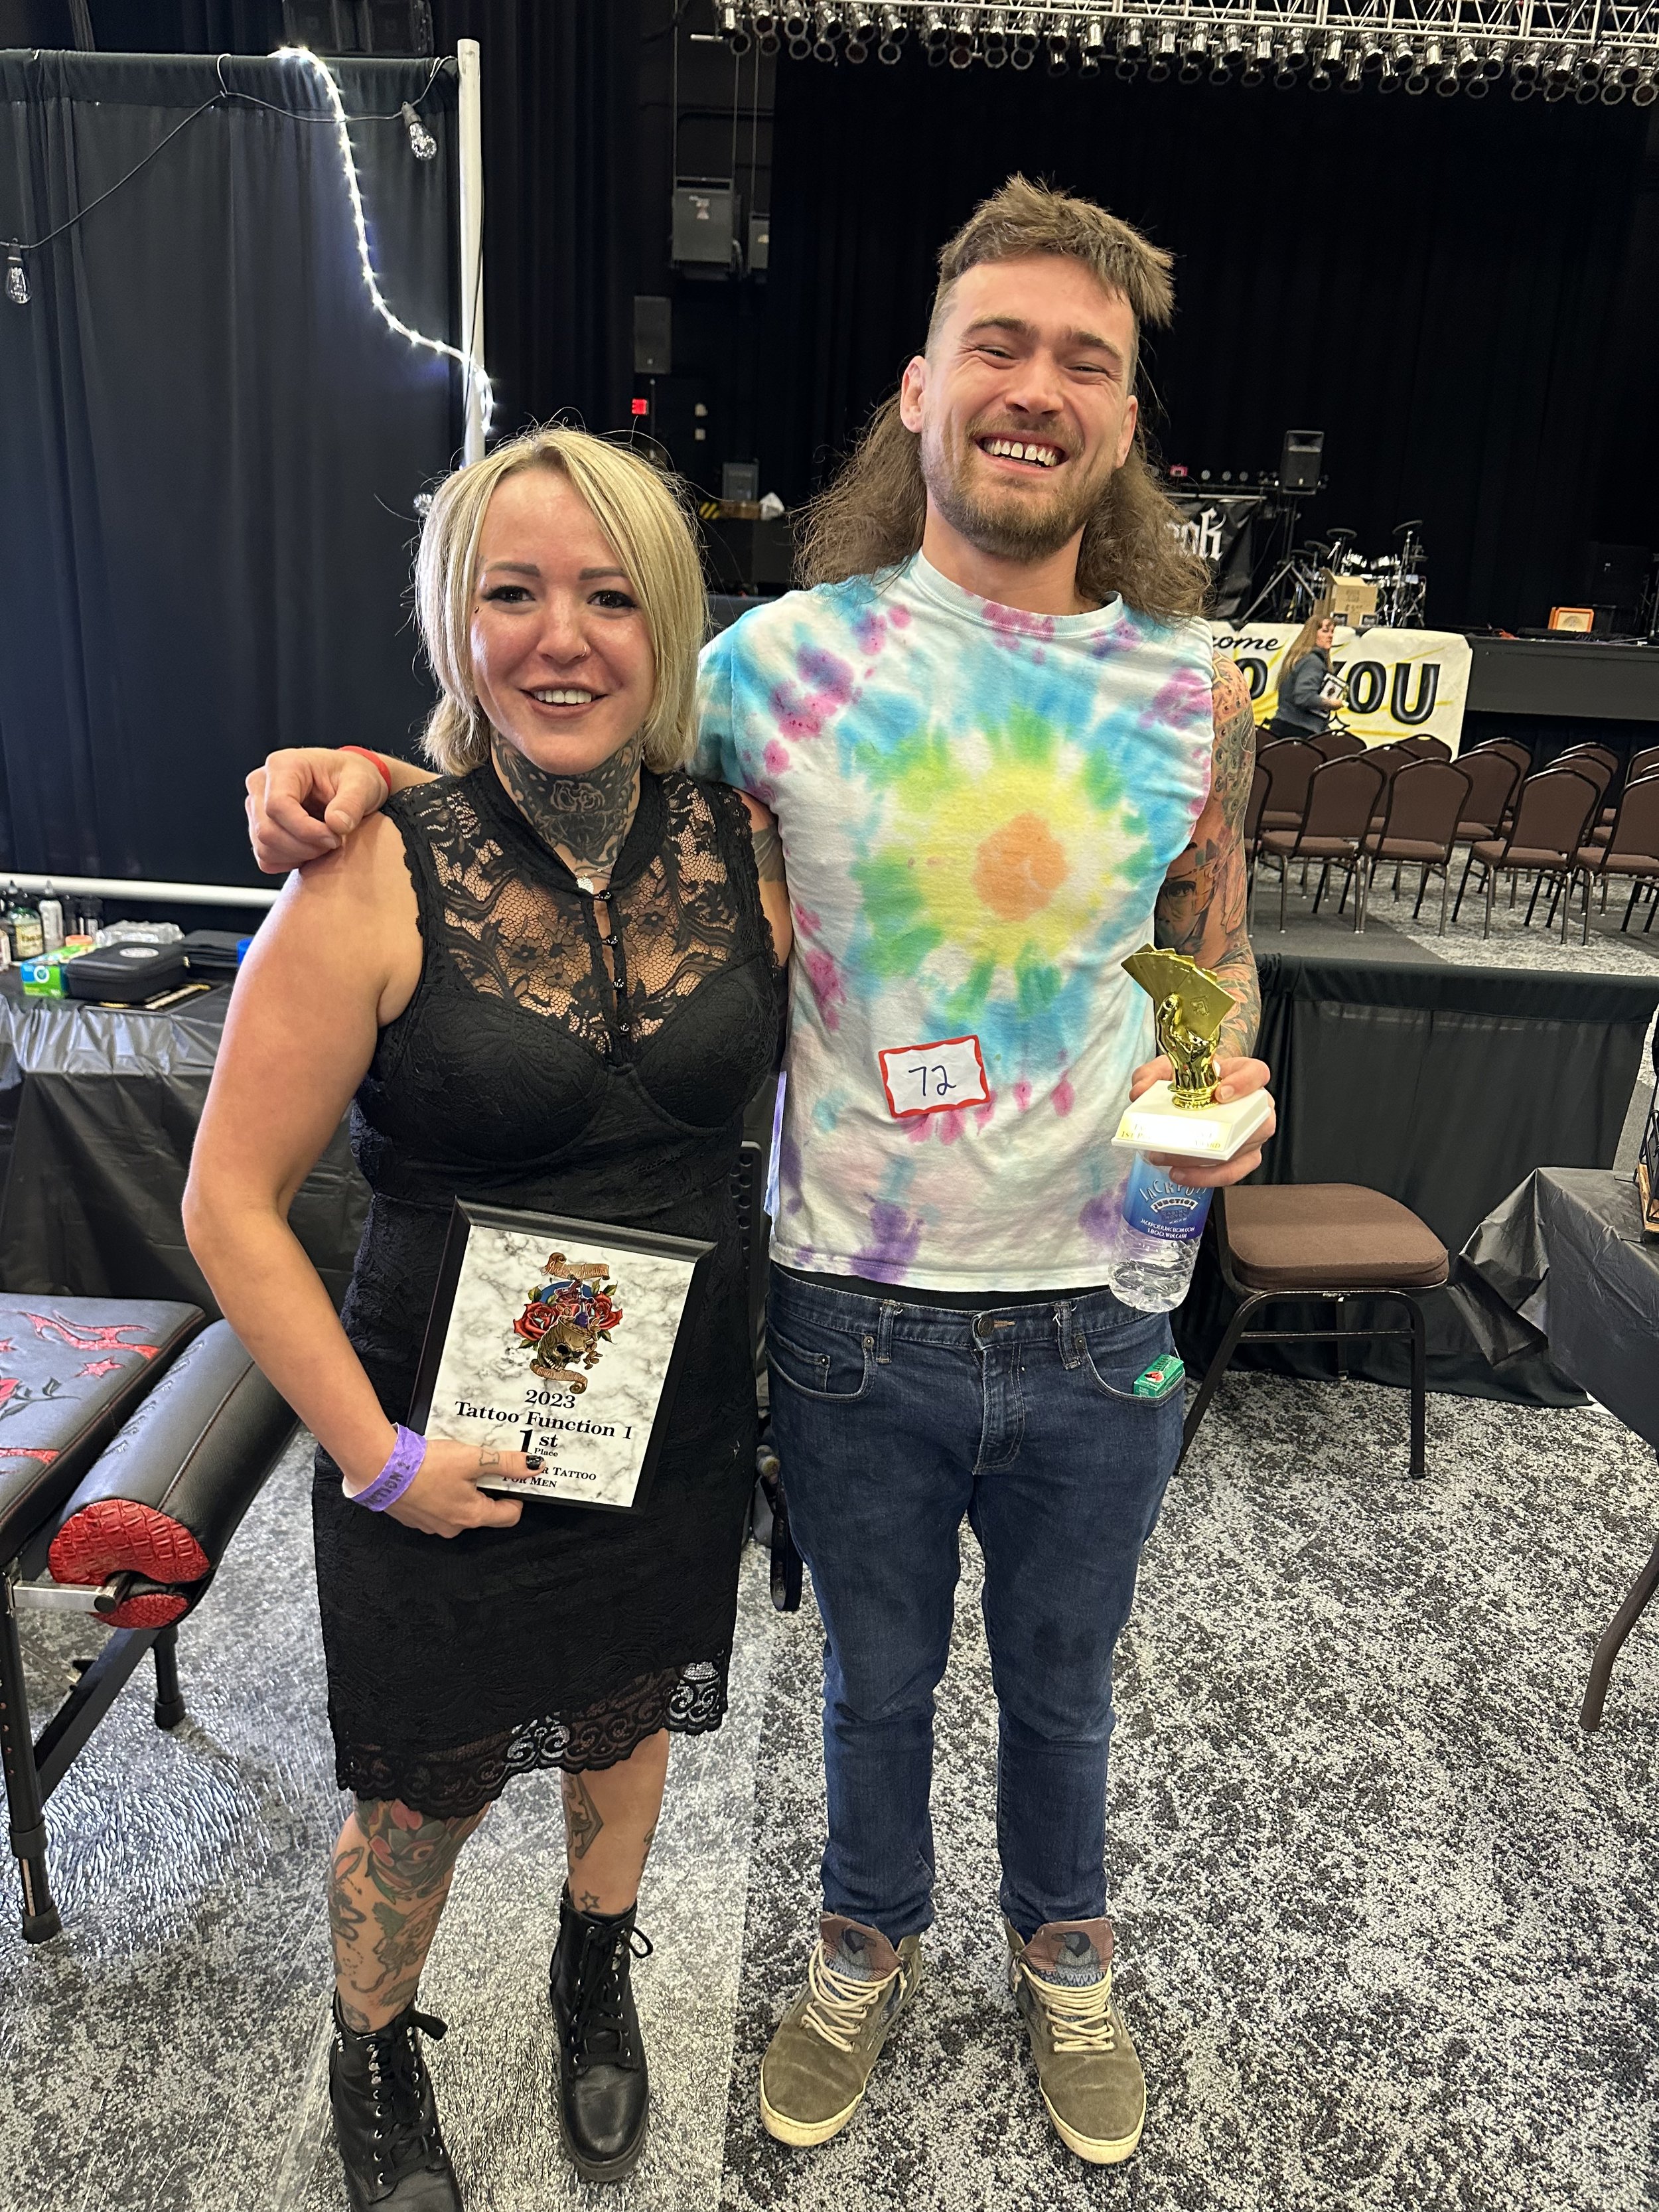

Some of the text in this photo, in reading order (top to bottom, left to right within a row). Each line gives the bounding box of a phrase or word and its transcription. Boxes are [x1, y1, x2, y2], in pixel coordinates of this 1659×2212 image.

[1333, 661, 1441, 725] OU
[908, 1065, 957, 1096] 72
[1153, 1198, 1195, 1209] JUNCTION
[524, 1389, 576, 1408] 2023
[455, 1401, 632, 1439] Tattoo Function 1
[534, 1447, 558, 1457] Place
[553, 1467, 597, 1481] TATTOO
[530, 1477, 557, 1488] MEN
